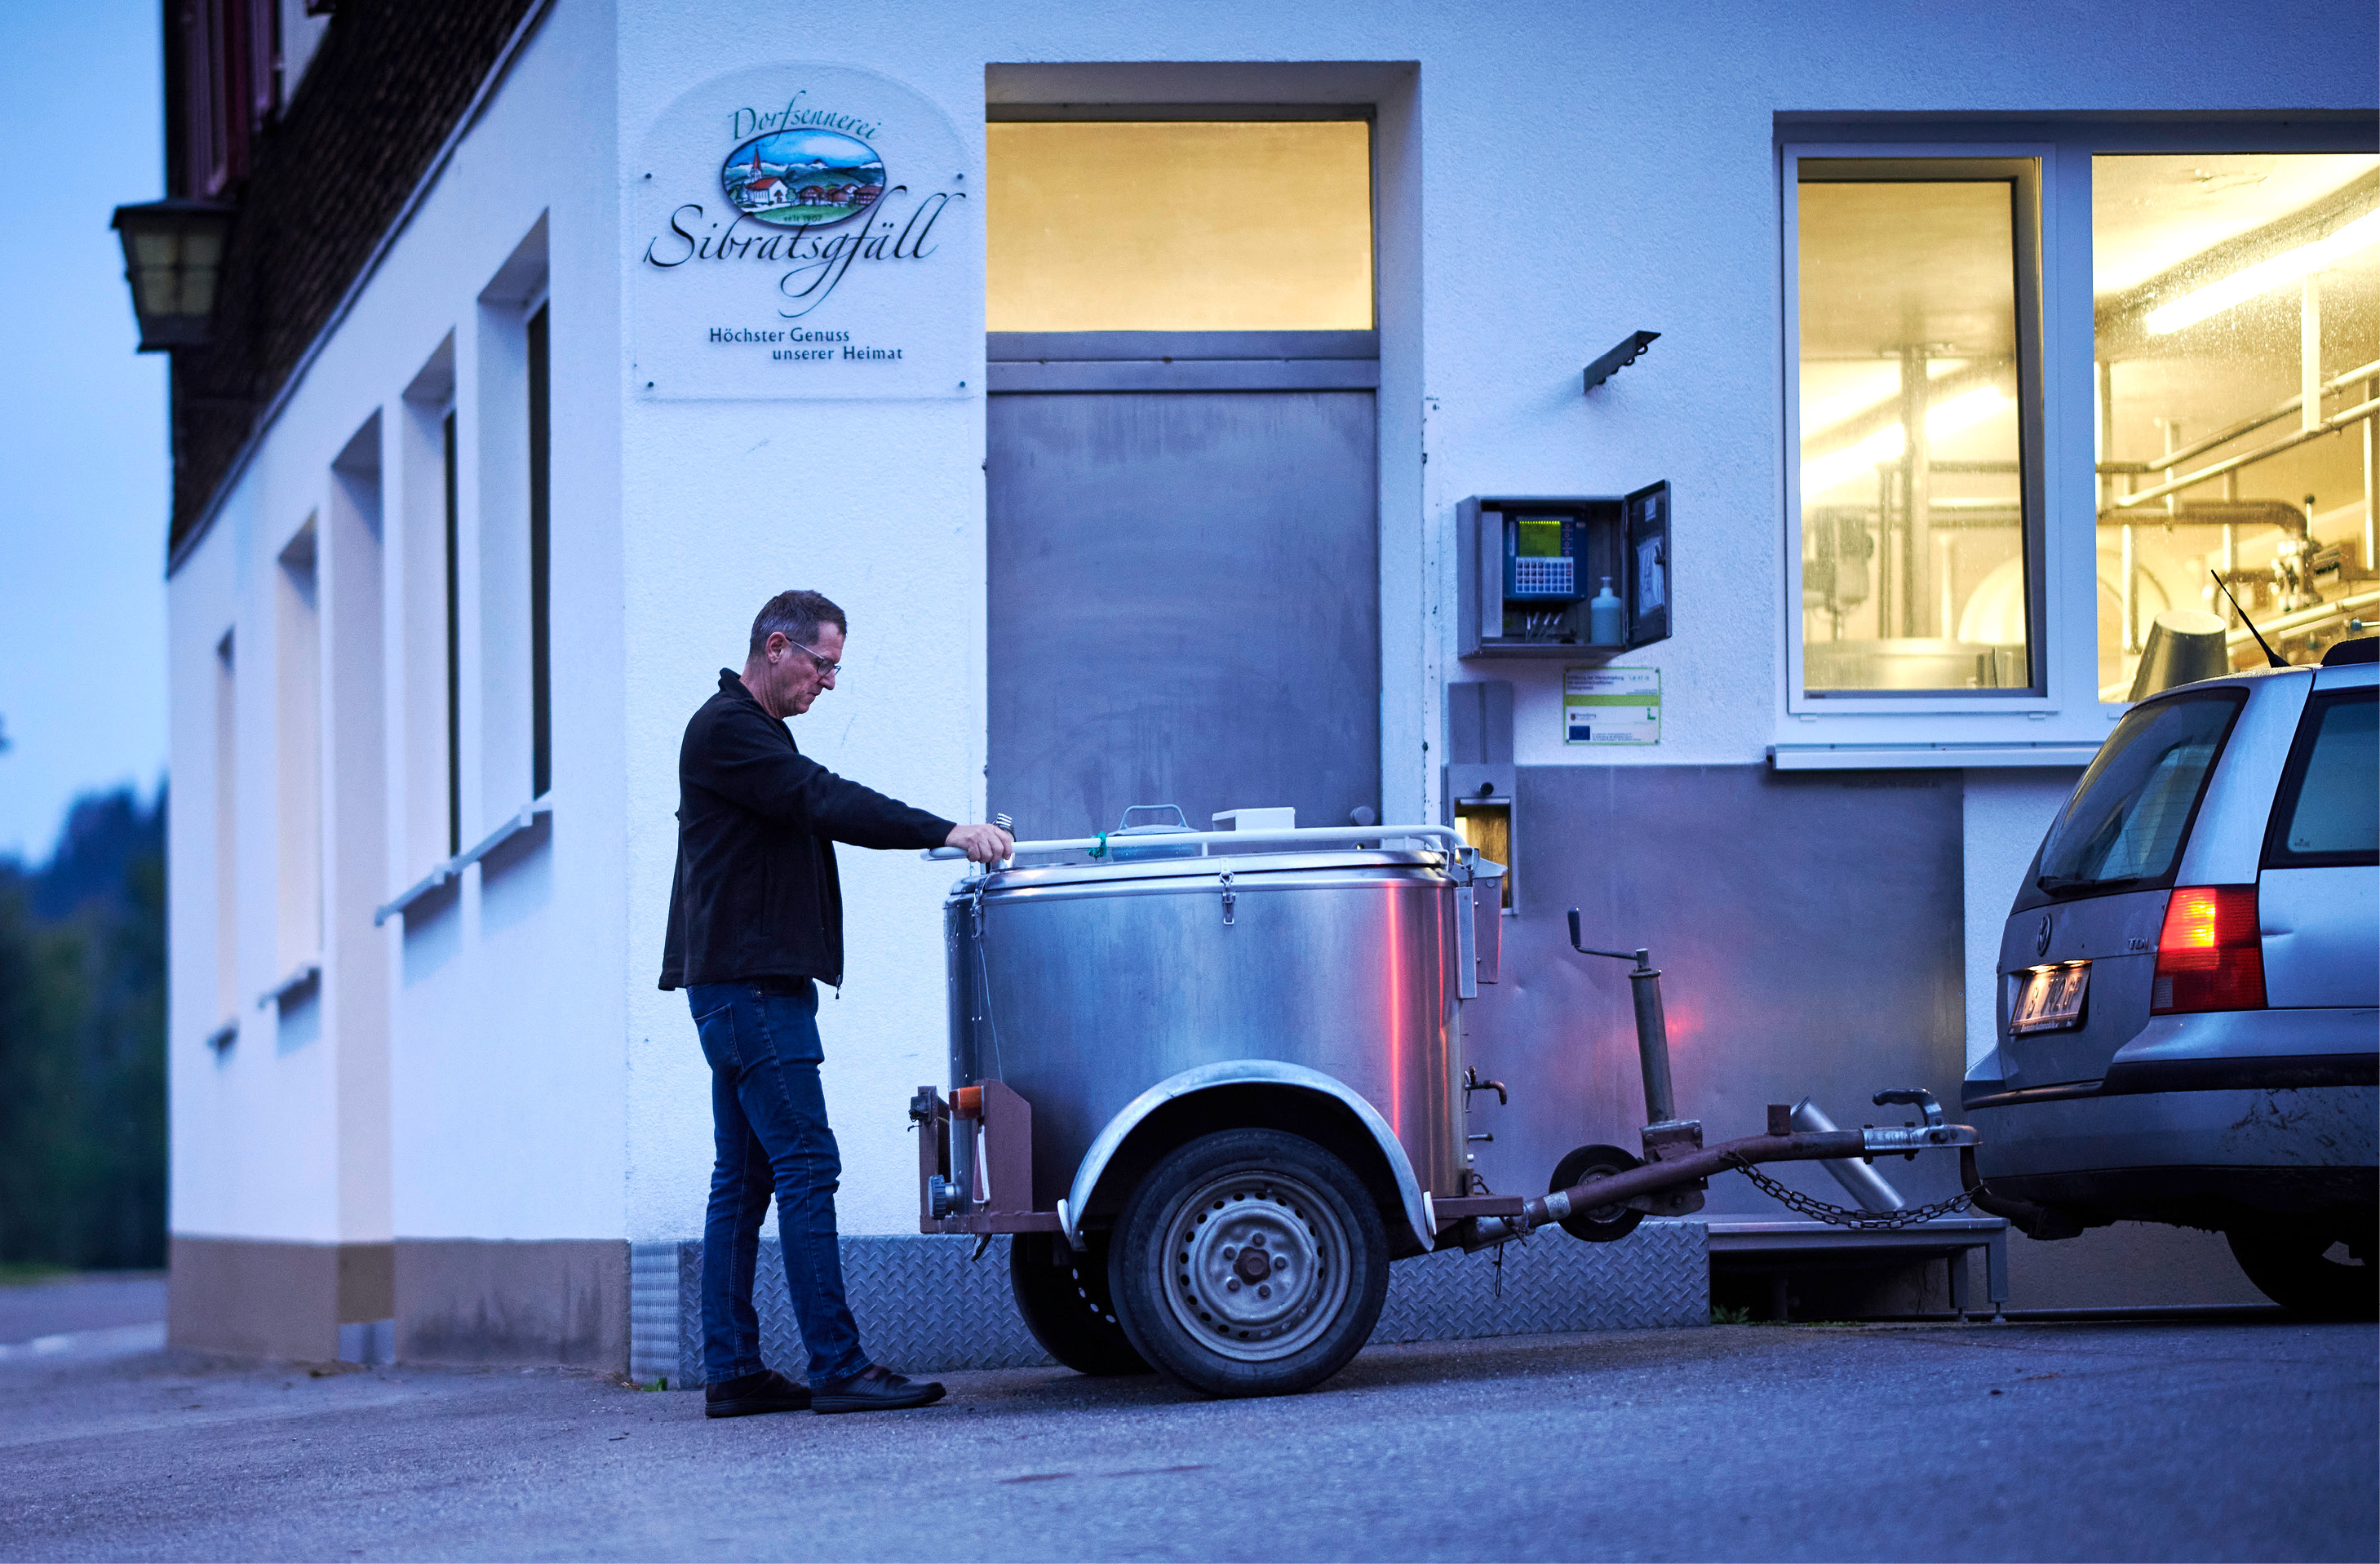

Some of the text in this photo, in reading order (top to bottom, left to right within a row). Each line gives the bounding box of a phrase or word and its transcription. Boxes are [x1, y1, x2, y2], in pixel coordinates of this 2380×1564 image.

[728, 90, 882, 146] Dorfsennerei
[643, 185, 966, 318] Sibratsgfäll
[709, 327, 850, 343] Höchster Genuss
[773, 345, 903, 360] unserer Heimat
[2128, 937, 2150, 950] TDI
